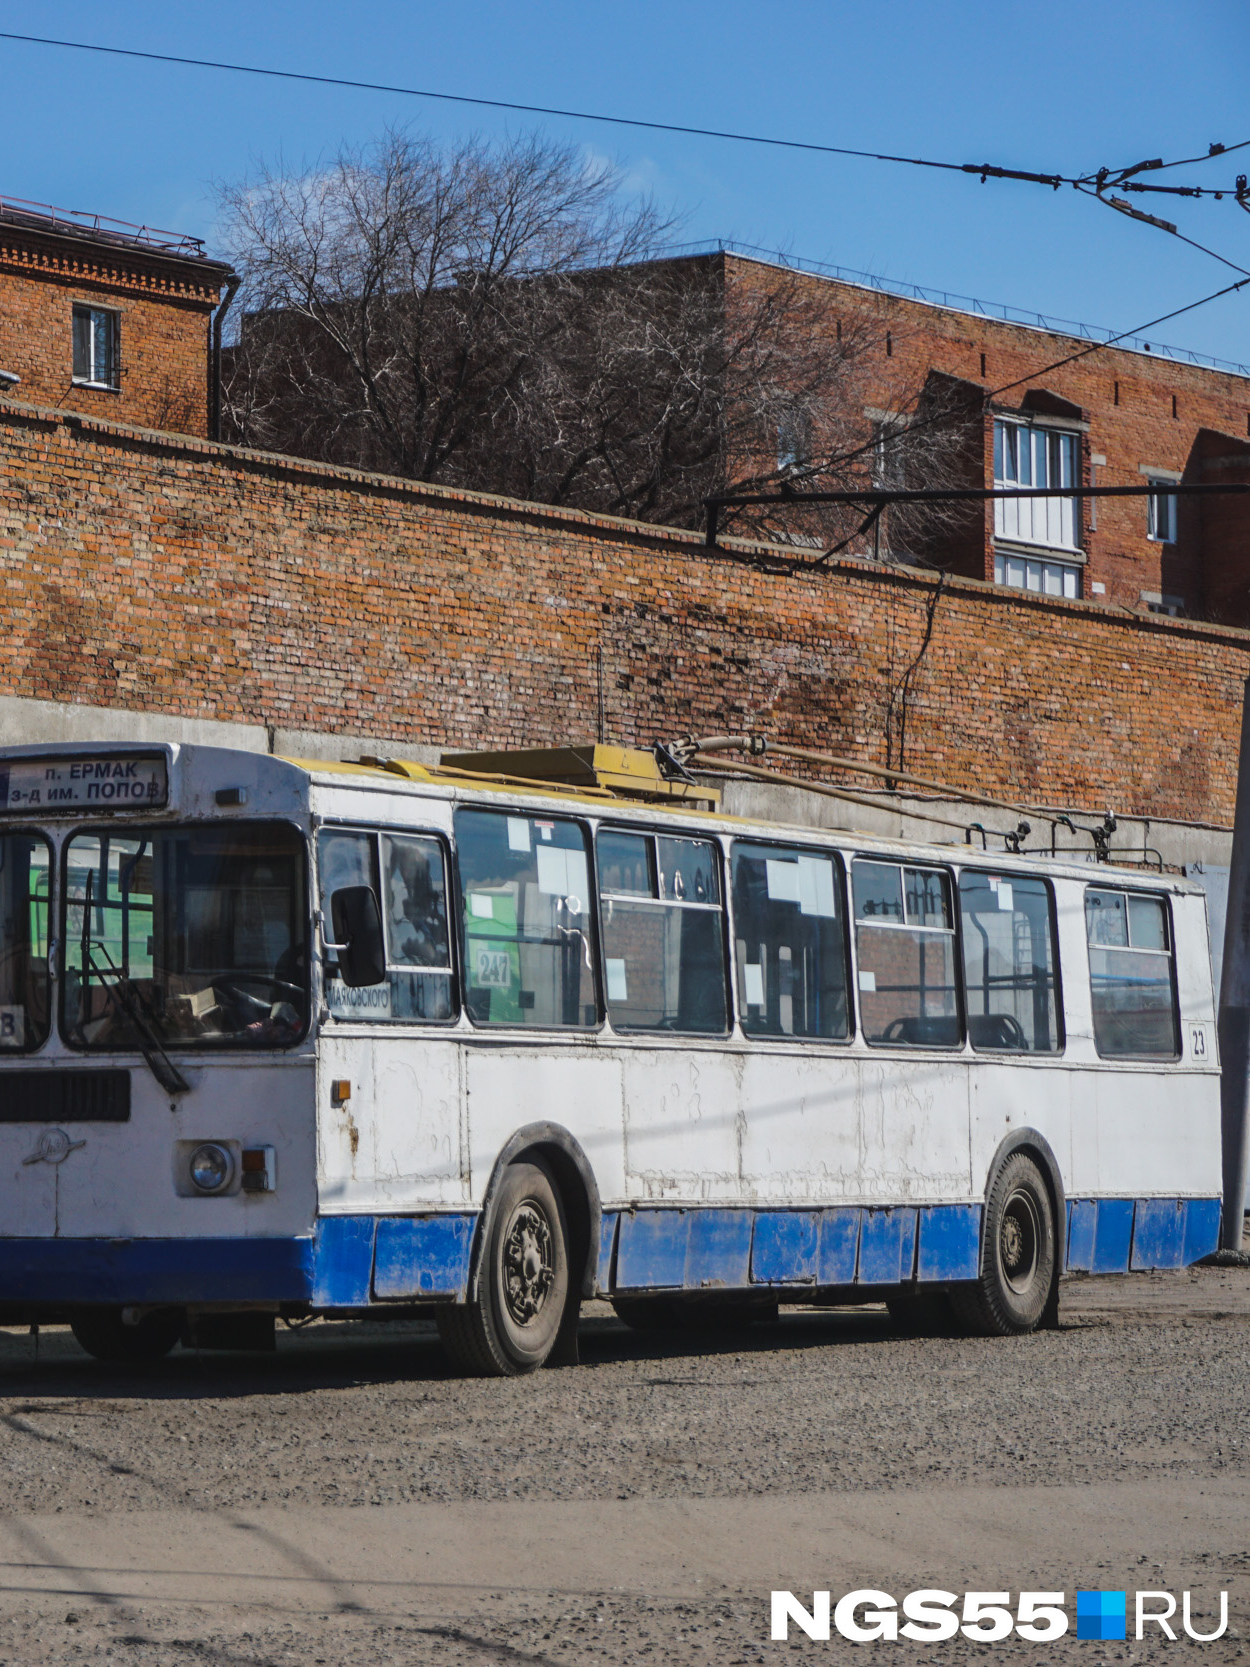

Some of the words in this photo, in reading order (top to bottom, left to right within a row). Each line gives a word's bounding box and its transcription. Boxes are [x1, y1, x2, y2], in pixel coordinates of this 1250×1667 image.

[45, 768, 61, 781] п.
[70, 762, 138, 779] ЕРМАК
[11, 788, 41, 804] з-д
[48, 787, 79, 801] им.
[479, 951, 508, 984] 247
[1192, 1030, 1205, 1055] 23
